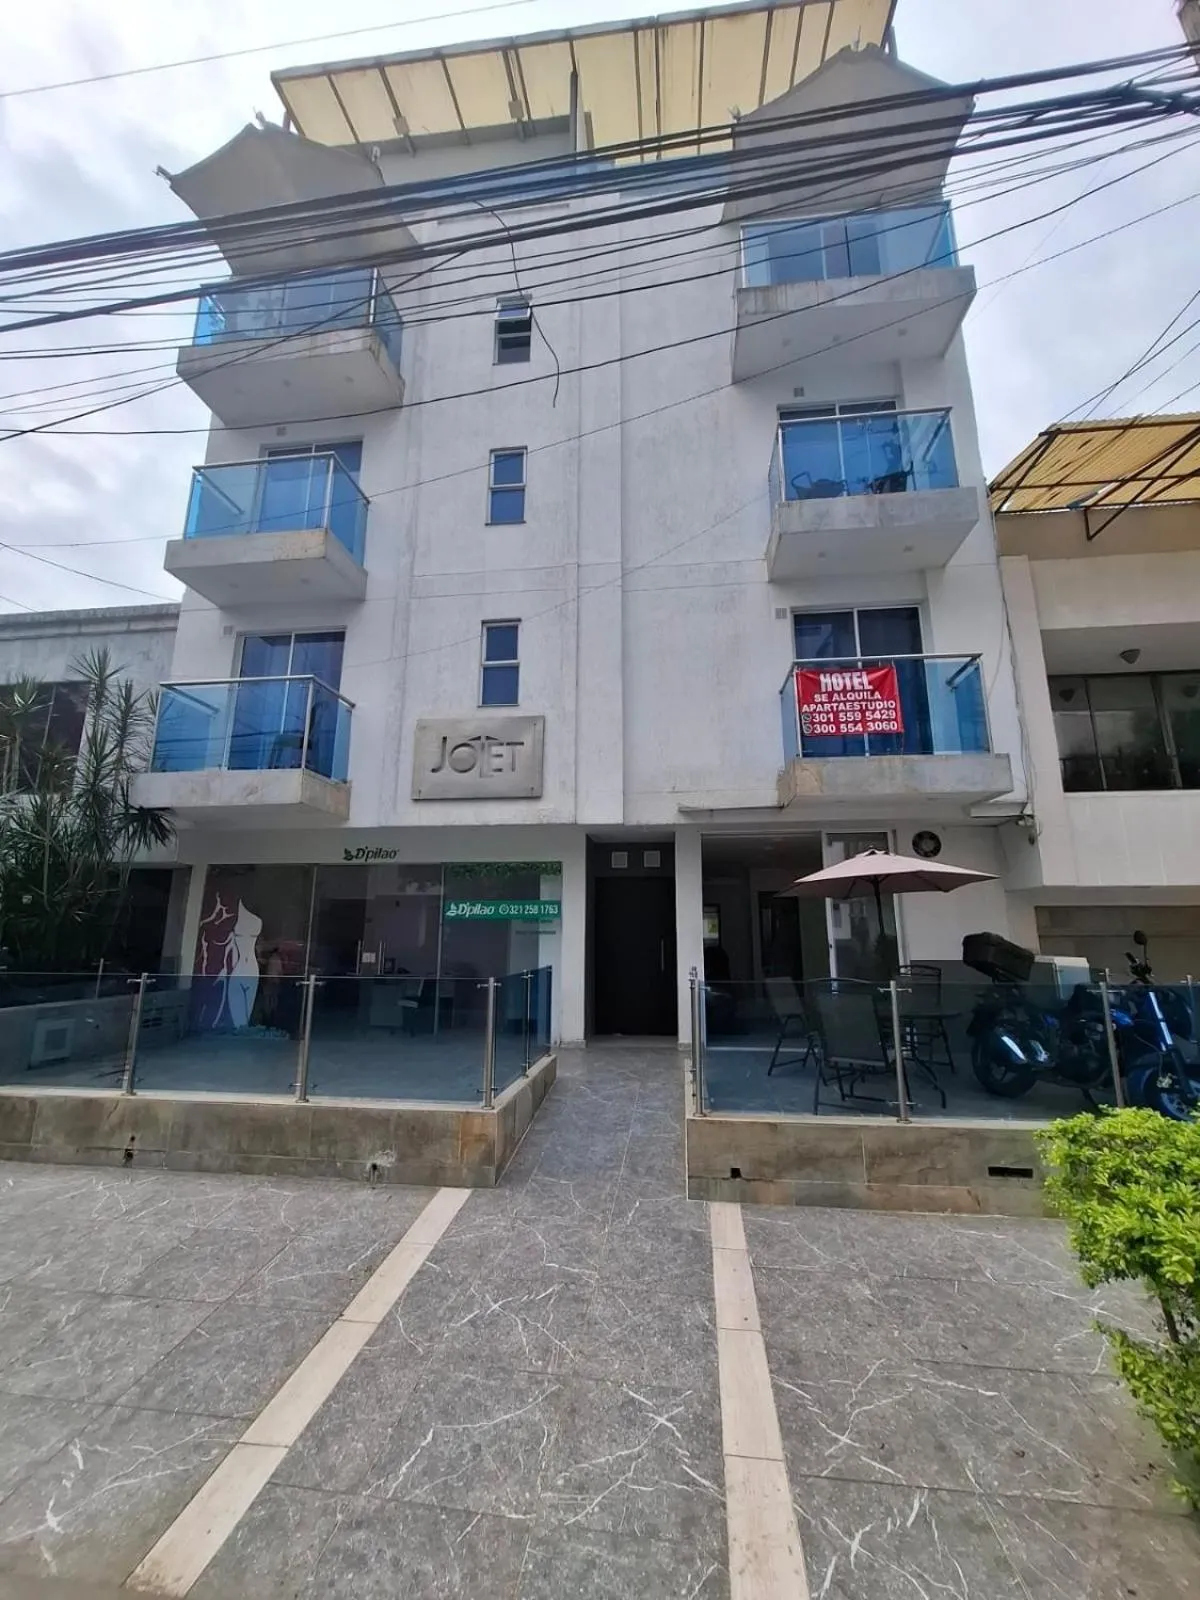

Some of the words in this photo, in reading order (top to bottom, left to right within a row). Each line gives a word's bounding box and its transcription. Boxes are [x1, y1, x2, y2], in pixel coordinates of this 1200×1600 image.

[820, 671, 873, 692] HOTEL
[814, 693, 829, 702] SE
[832, 691, 881, 701] ALQUILA
[802, 700, 896, 712] APARTAESTUDIO
[812, 713, 835, 722] 301
[839, 711, 862, 721] 559
[865, 709, 896, 720] 5429
[814, 723, 836, 733] 300
[840, 722, 863, 732] 554
[867, 721, 898, 731] 3060
